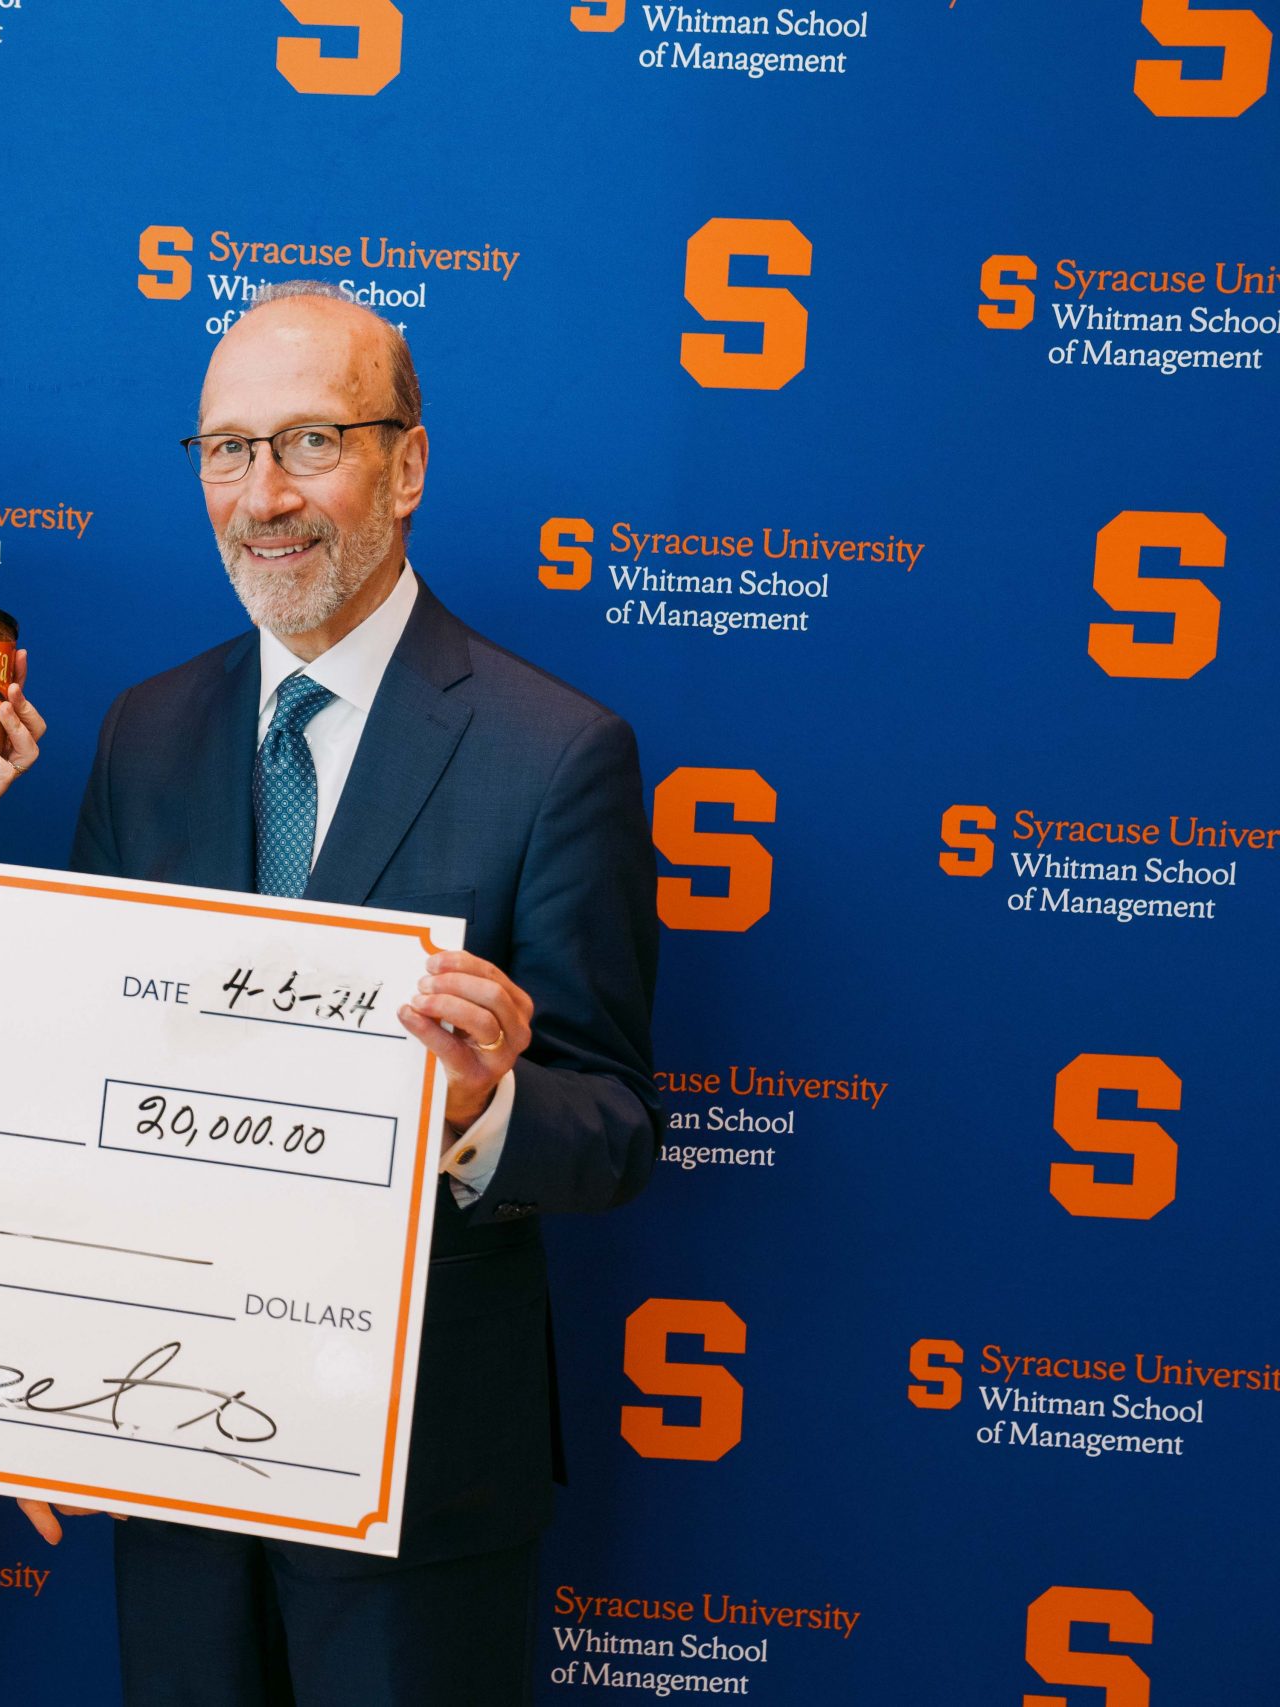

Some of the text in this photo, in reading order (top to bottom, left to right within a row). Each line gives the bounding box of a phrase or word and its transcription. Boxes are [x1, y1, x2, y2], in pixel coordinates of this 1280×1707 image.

[642, 5, 769, 34] Whitman
[776, 9, 867, 37] School
[639, 42, 846, 78] of Management
[138, 225, 193, 300] S
[209, 231, 520, 281] Syracuse University
[978, 254, 1038, 330] S
[1054, 259, 1206, 299] Syracuse
[680, 218, 812, 391] S
[1052, 303, 1182, 331] Whitman
[1049, 339, 1262, 374] of Management
[538, 517, 595, 591] S
[610, 522, 925, 572] Syracuse University
[608, 561, 828, 597] Whitman School
[1088, 510, 1227, 680] S
[606, 600, 808, 635] of Management
[651, 766, 777, 933] S
[938, 804, 997, 878] S
[1012, 809, 1280, 849] Syracuse Univer
[1010, 851, 1236, 886] Whitman School
[1008, 887, 1215, 922] of Management
[122, 975, 191, 1005] DATE
[652, 1066, 888, 1110] cuse University
[136, 1095, 326, 1155] 20,000.00
[706, 1107, 794, 1134] School
[1049, 1052, 1182, 1221] S
[244, 1292, 373, 1333] DOLLARS
[620, 1297, 748, 1463] S
[907, 1337, 965, 1411] S
[980, 1344, 1280, 1392] Syracuse Universit
[979, 1386, 1204, 1424] Whitman School
[977, 1421, 1183, 1457] of Management
[554, 1585, 861, 1639] Syracuse University
[552, 1627, 768, 1663] Whitman School
[551, 1661, 748, 1696] of Management
